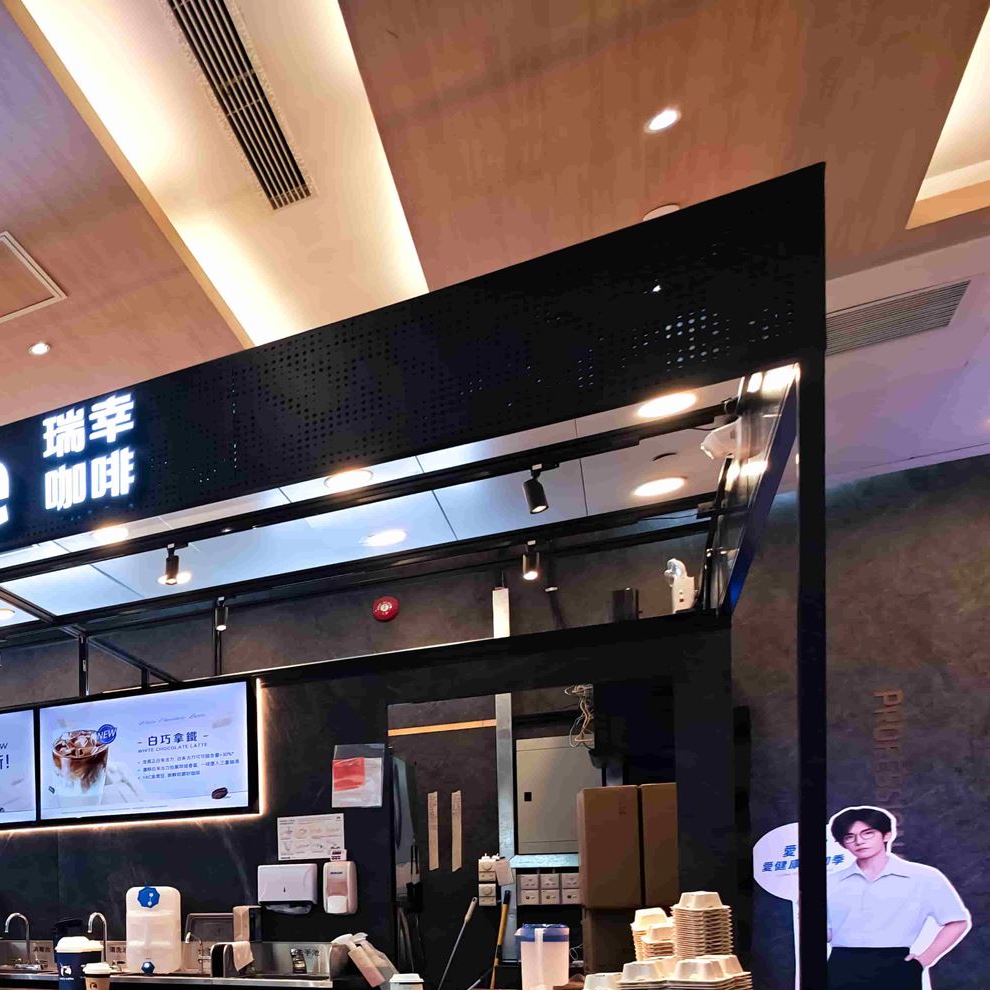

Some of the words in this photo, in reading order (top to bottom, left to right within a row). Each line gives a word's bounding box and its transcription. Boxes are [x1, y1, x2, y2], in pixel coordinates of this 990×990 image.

[42, 393, 135, 459] 瑞幸
[44, 446, 135, 511] 咖啡
[97, 727, 117, 740] NEW
